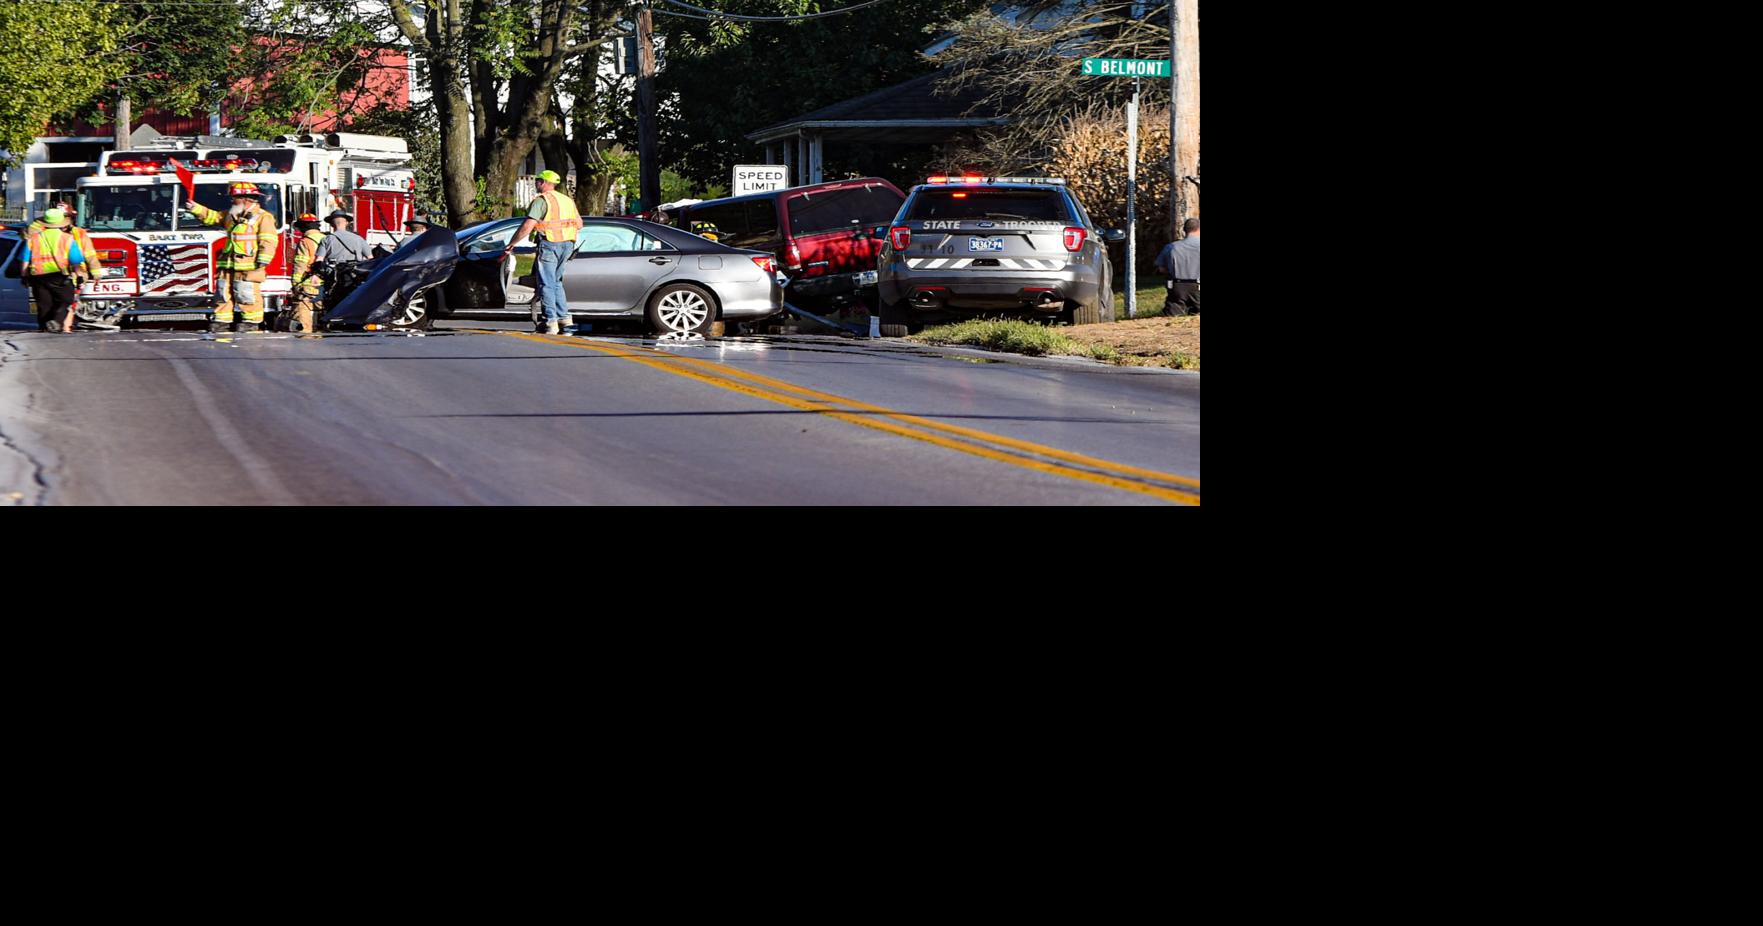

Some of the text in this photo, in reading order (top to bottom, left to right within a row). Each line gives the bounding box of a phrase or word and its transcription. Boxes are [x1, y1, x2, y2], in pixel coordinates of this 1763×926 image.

[1084, 60, 1163, 75] S BELMONT
[738, 171, 783, 180] SPEED
[743, 182, 777, 191] LIMIT
[923, 220, 961, 230] STATE
